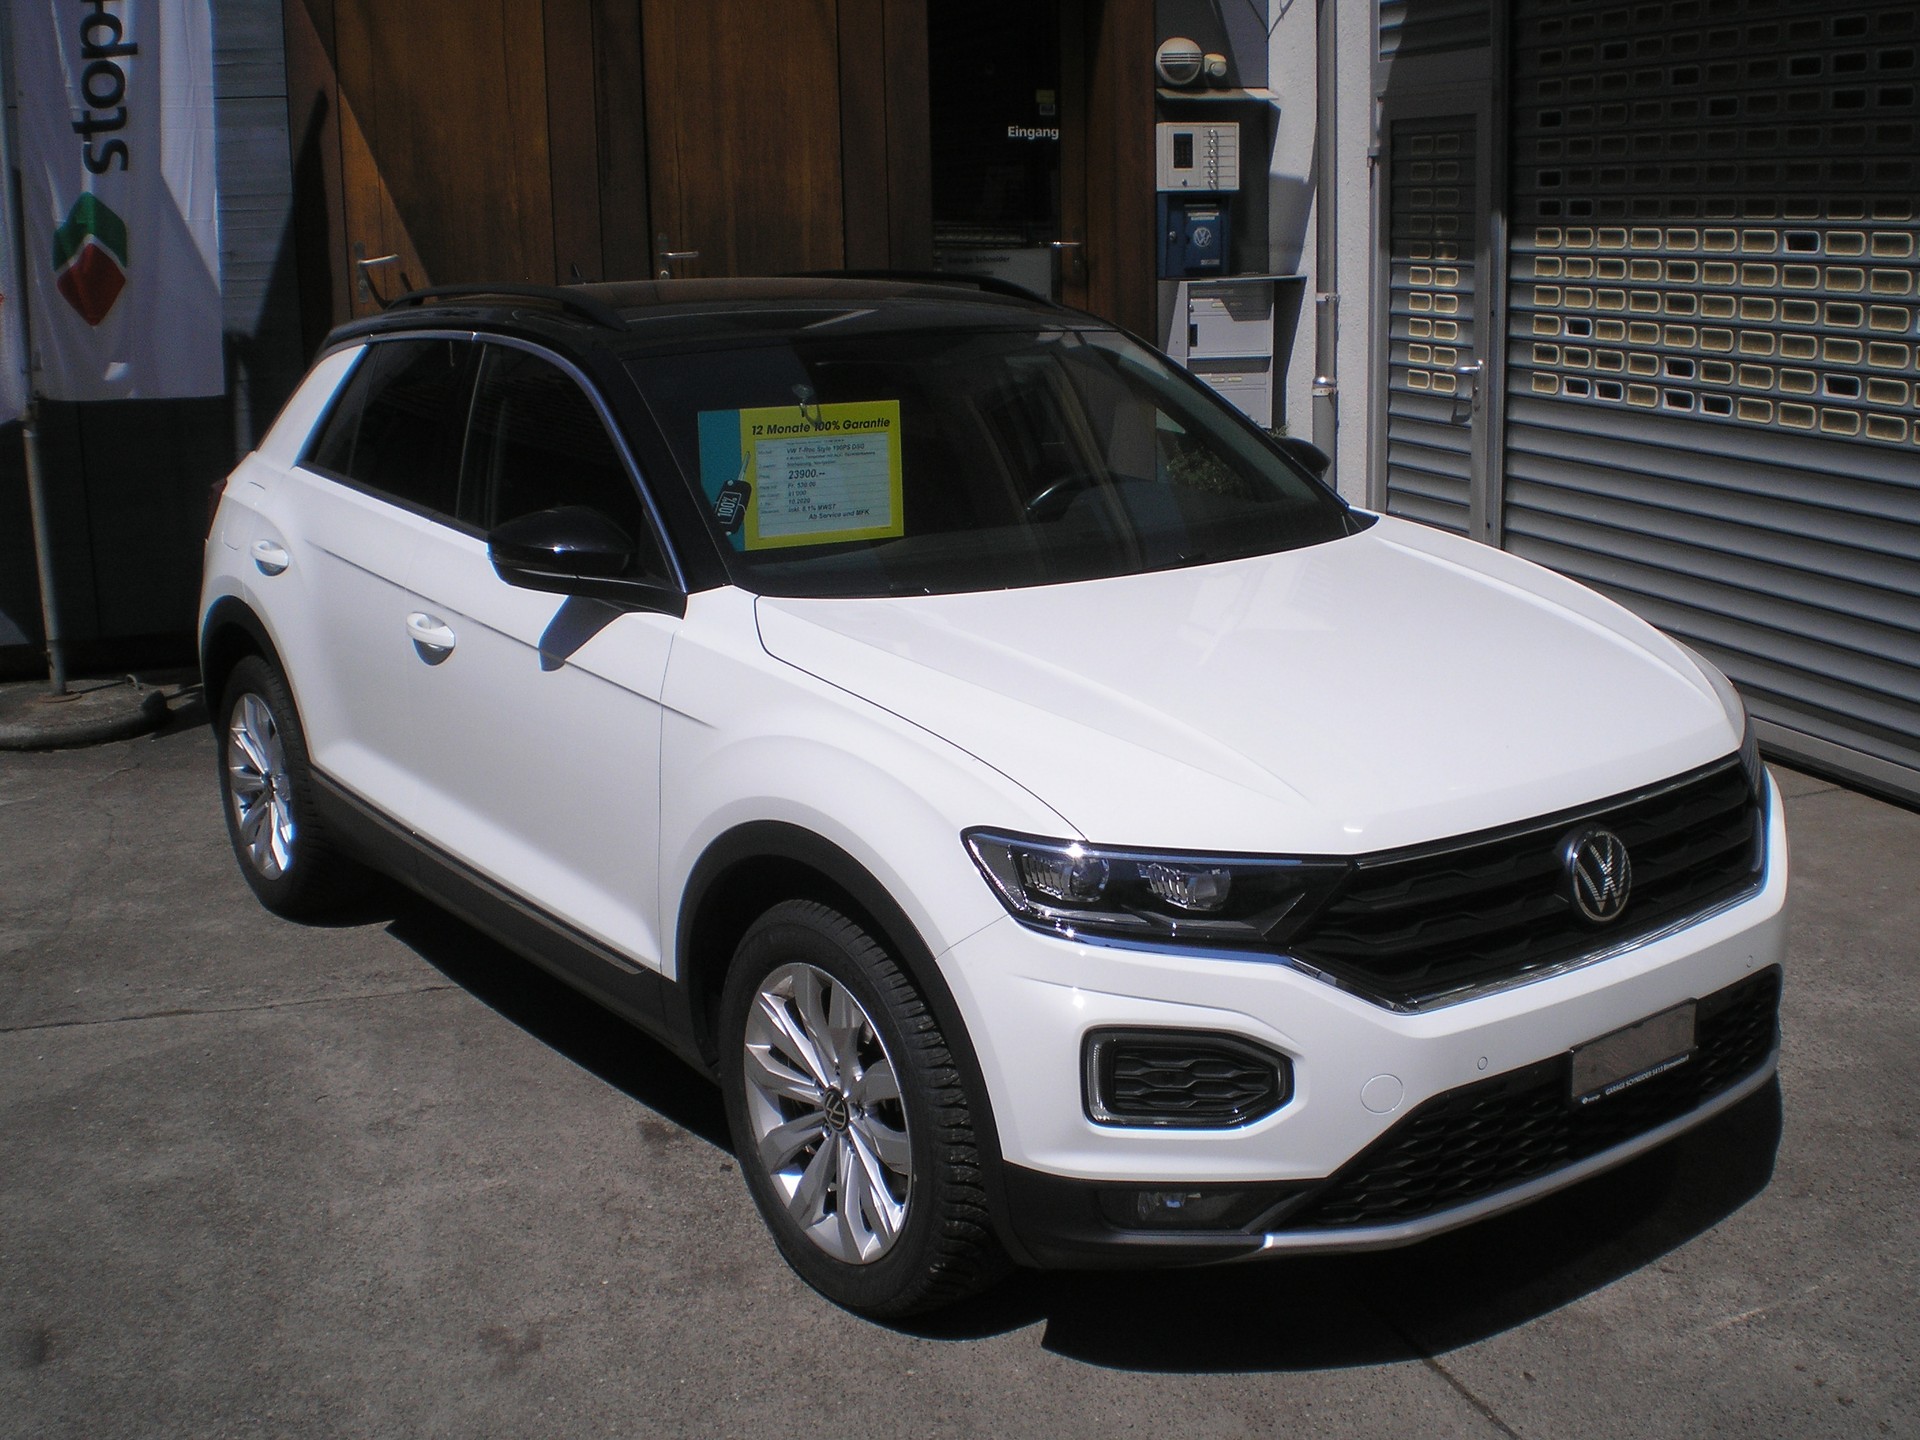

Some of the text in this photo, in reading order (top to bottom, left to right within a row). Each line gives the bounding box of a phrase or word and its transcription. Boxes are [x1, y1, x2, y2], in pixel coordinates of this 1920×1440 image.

[1007, 125, 1059, 140] Eingang
[752, 418, 889, 435] 12 Monate 100% Garantie
[788, 468, 826, 479] 23900.--
[717, 496, 738, 517] 100%
